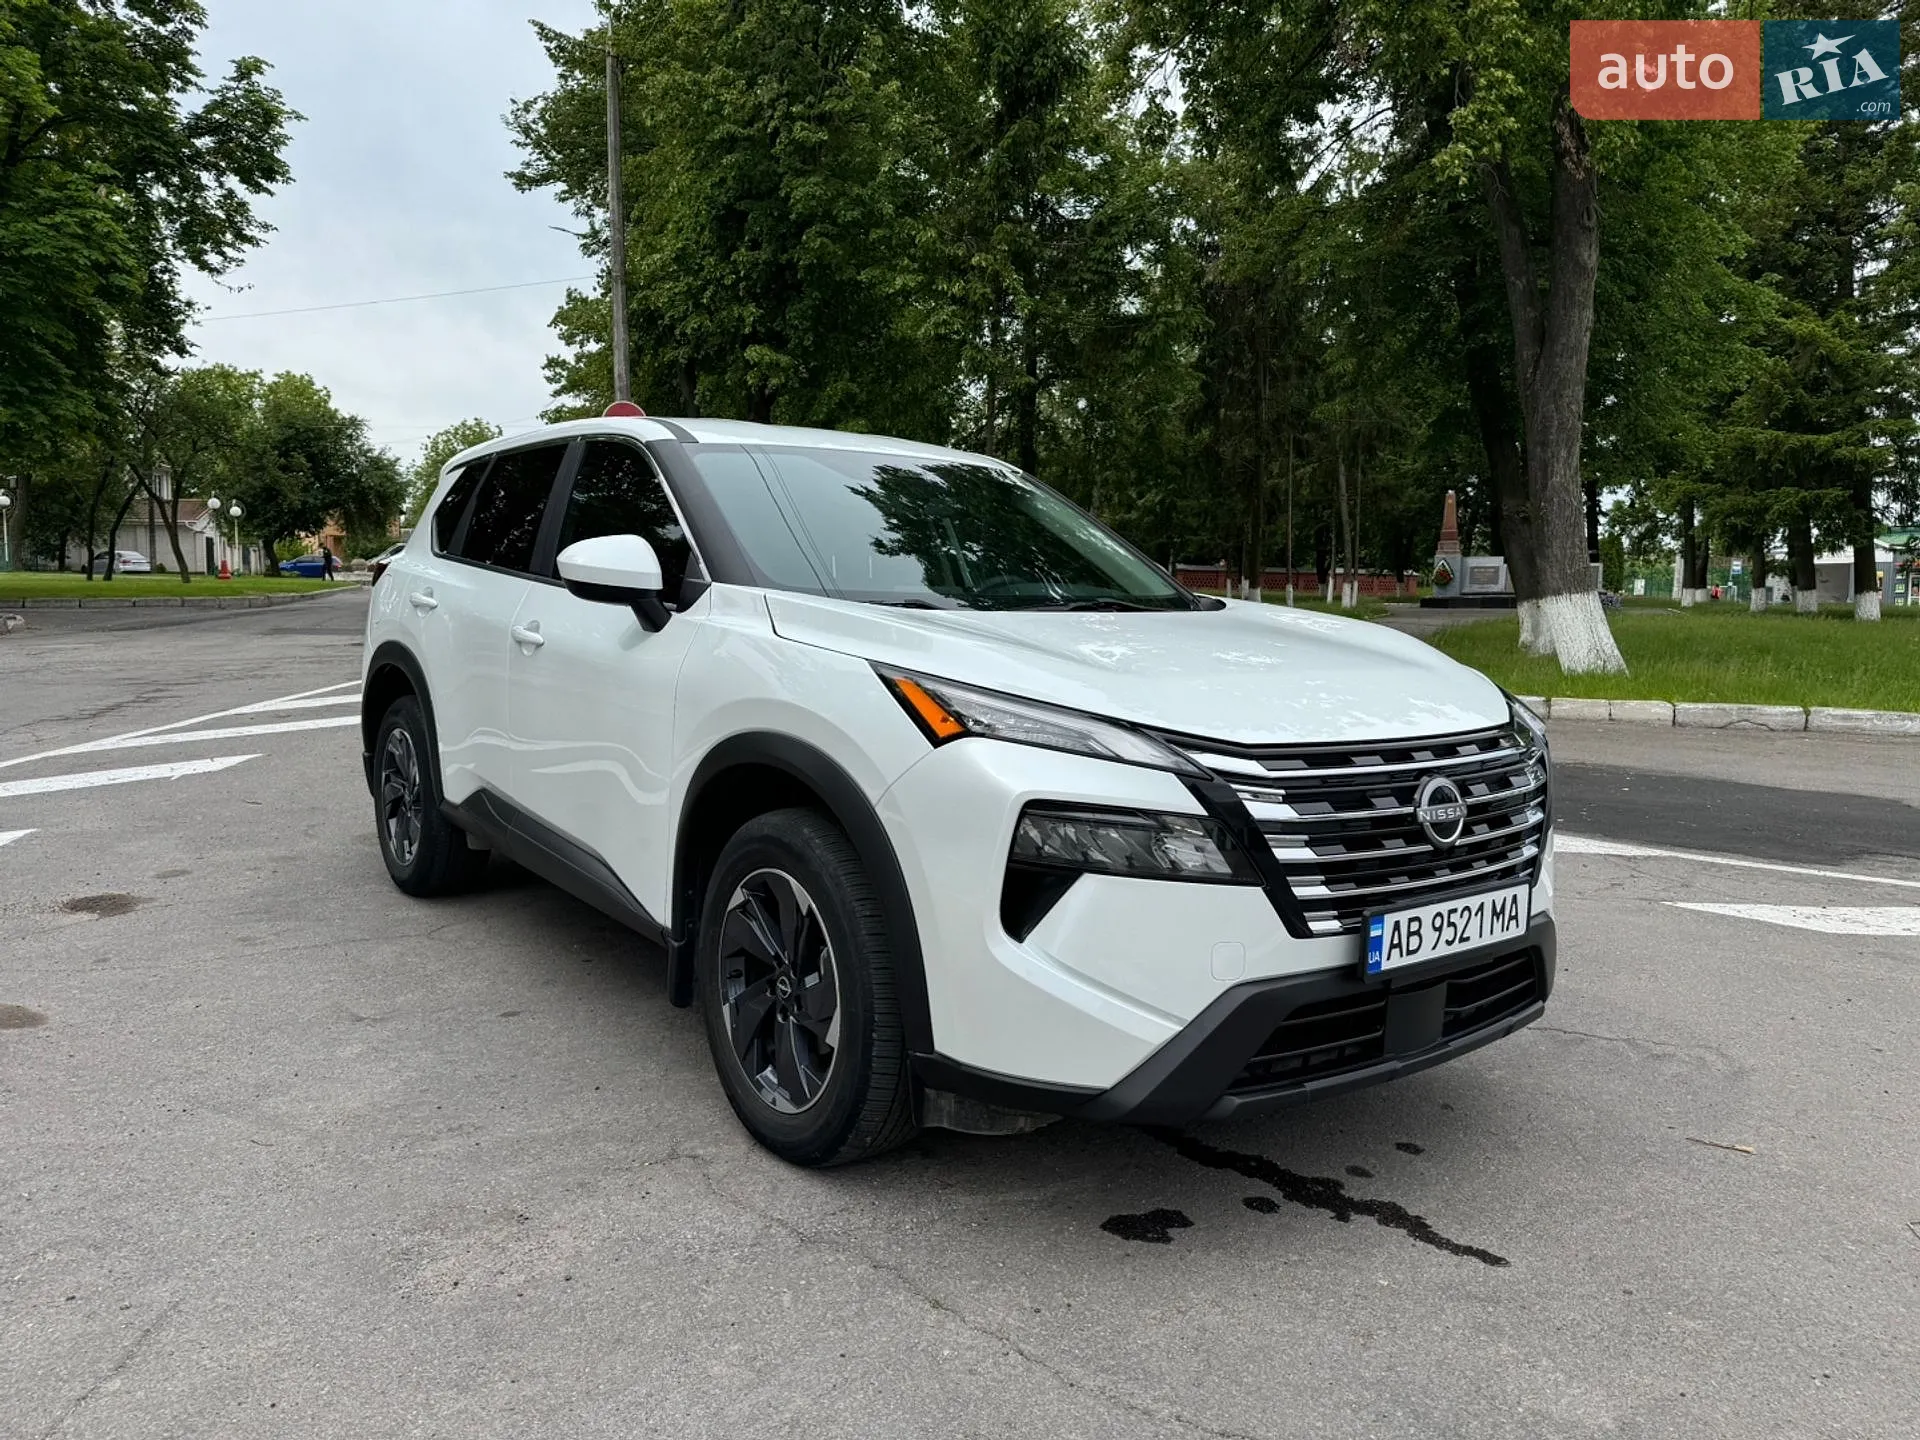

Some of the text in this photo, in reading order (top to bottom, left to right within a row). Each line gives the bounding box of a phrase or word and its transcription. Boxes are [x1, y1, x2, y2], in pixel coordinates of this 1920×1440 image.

[1386, 893, 1519, 961] AB 9521 MA
[1368, 951, 1380, 964] UA
